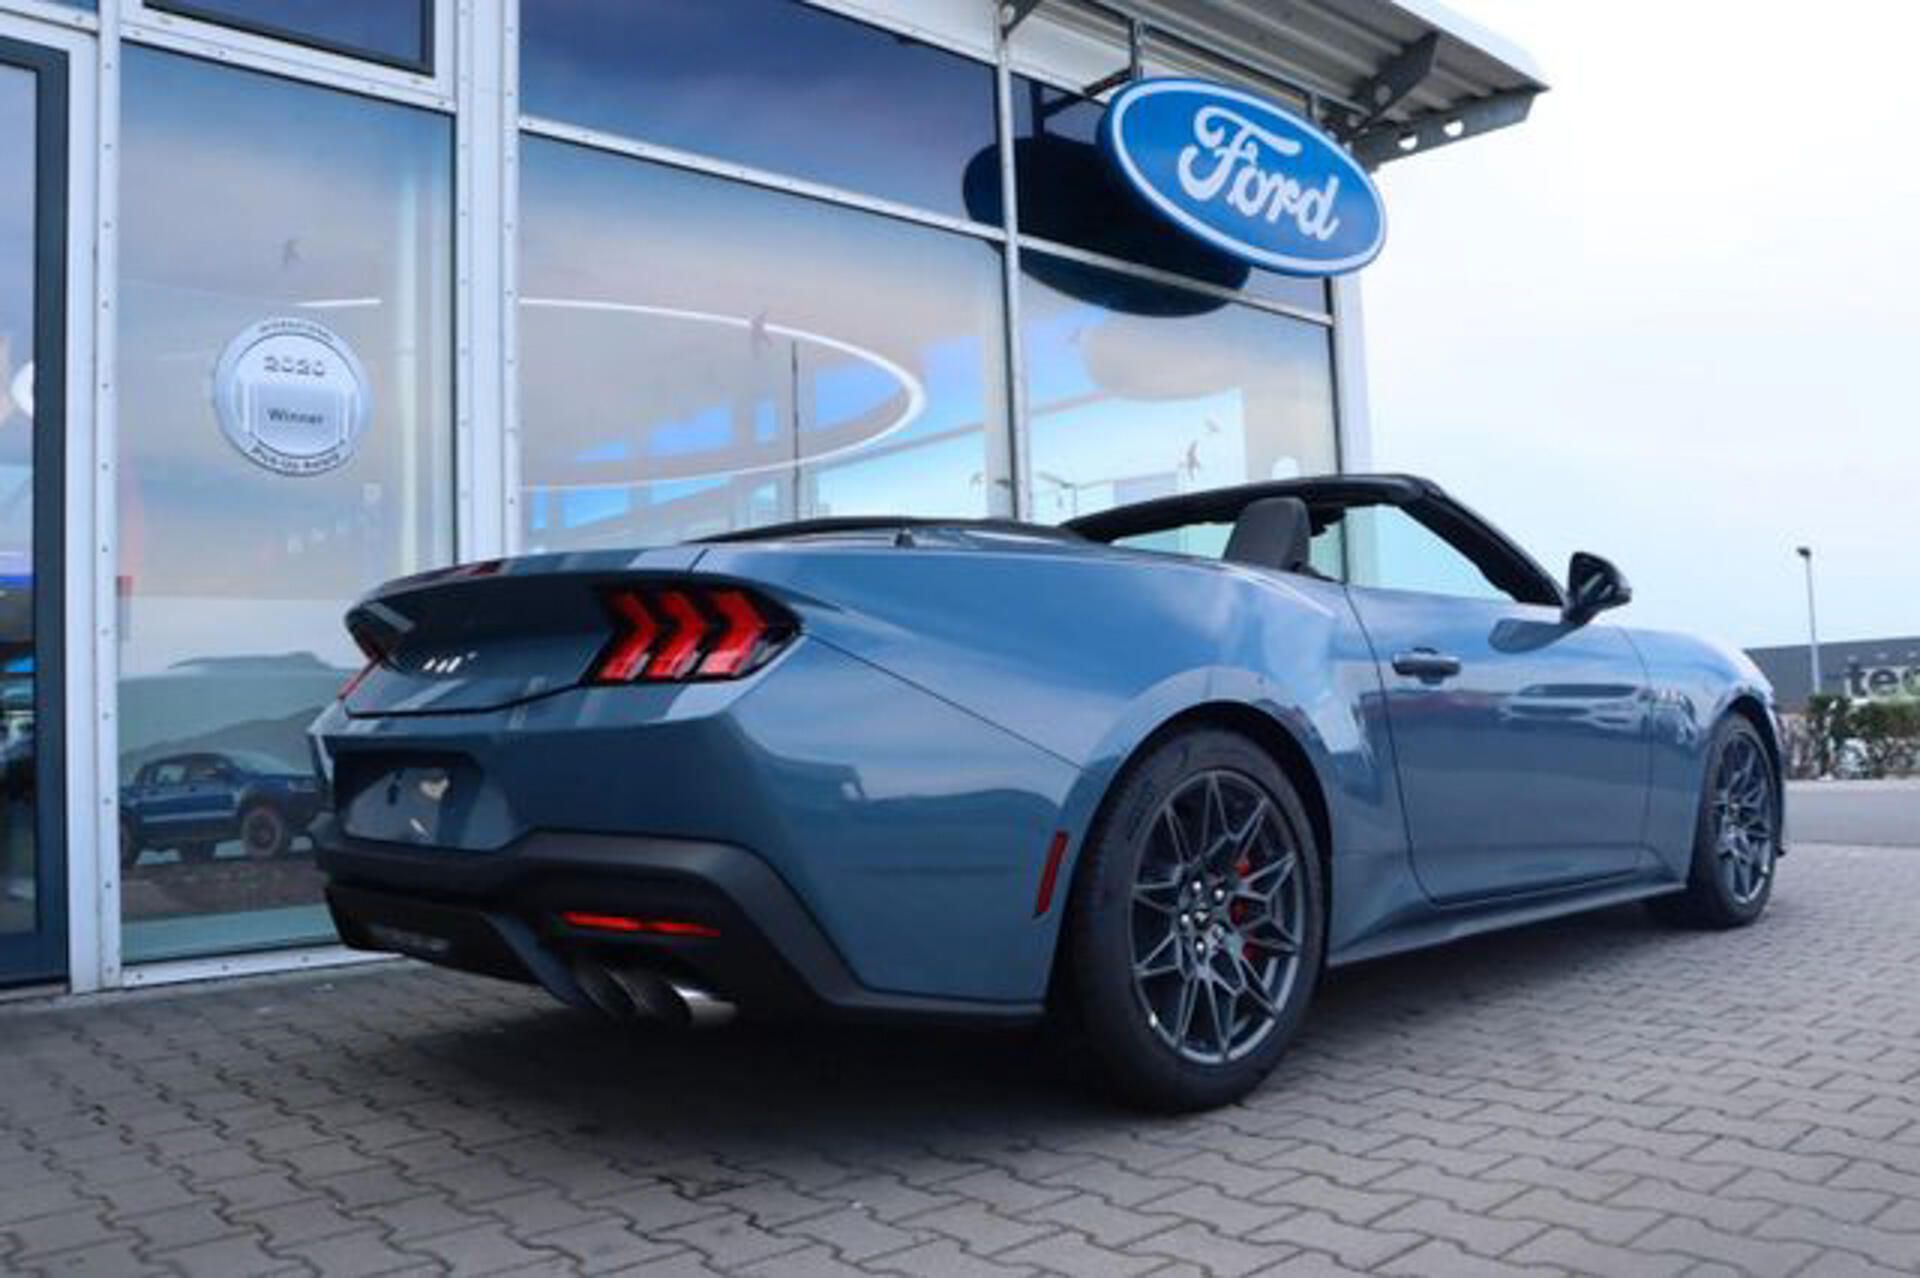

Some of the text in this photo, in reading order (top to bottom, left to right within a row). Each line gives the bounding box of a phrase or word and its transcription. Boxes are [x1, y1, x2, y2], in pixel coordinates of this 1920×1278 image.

[1178, 105, 1340, 241] Ford
[263, 355, 326, 377] 2020
[266, 407, 325, 425] Winner
